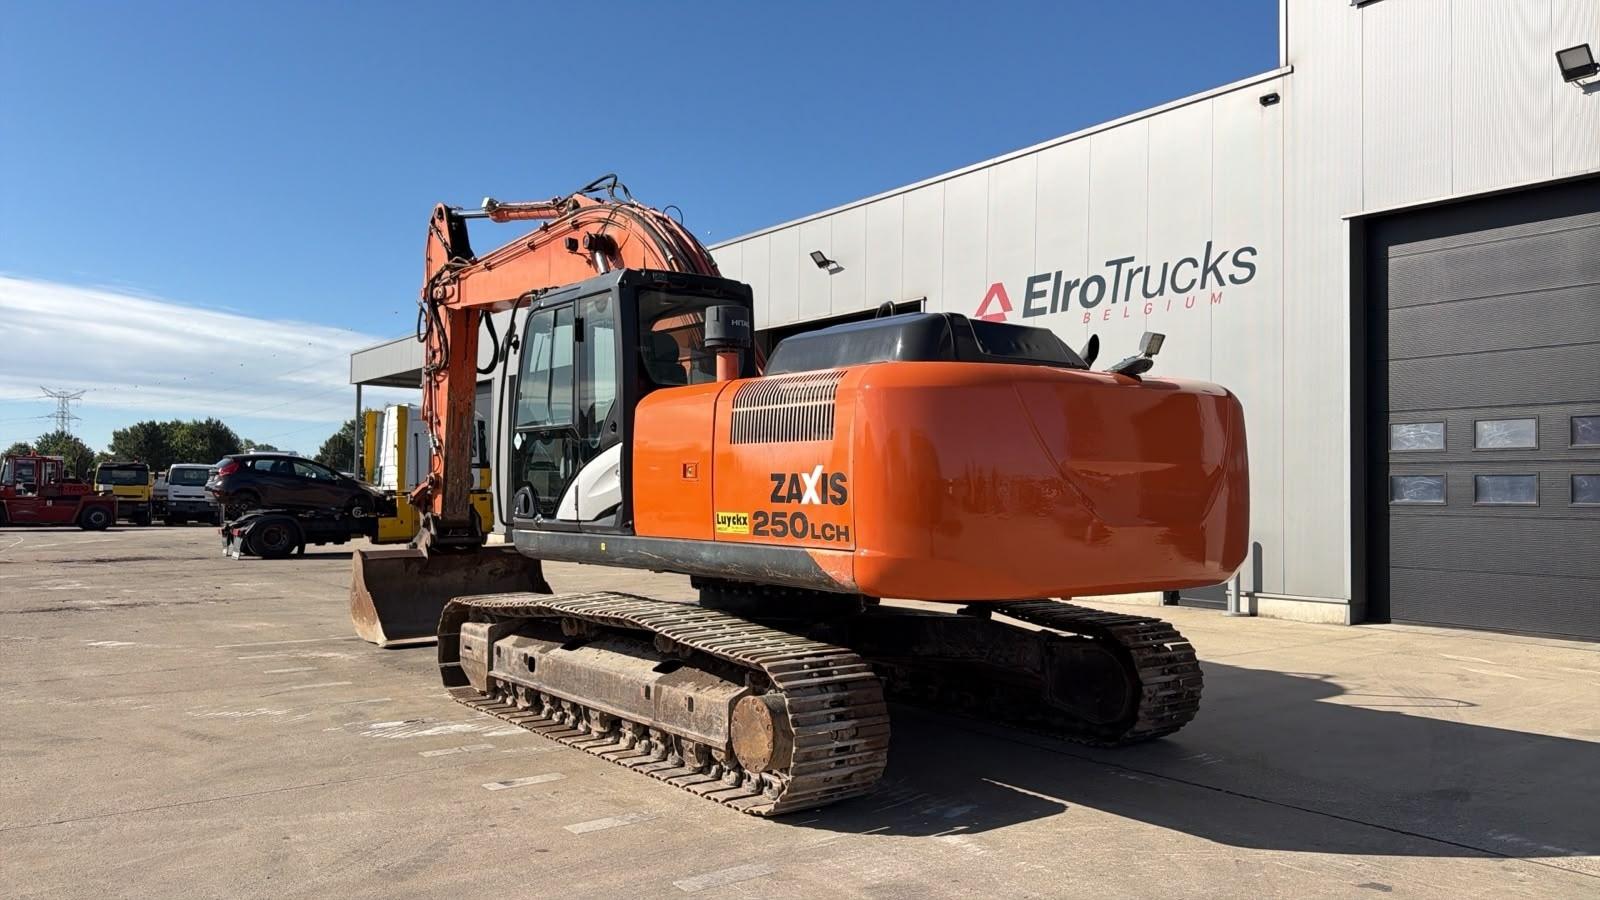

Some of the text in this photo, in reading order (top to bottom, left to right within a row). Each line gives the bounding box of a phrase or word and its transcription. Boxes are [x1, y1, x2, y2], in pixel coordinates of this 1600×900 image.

[1022, 240, 1257, 318] ElroTrucks
[1082, 291, 1224, 324] BELGIUM
[770, 464, 848, 505] ZAXIS
[716, 513, 748, 528] Luyckx
